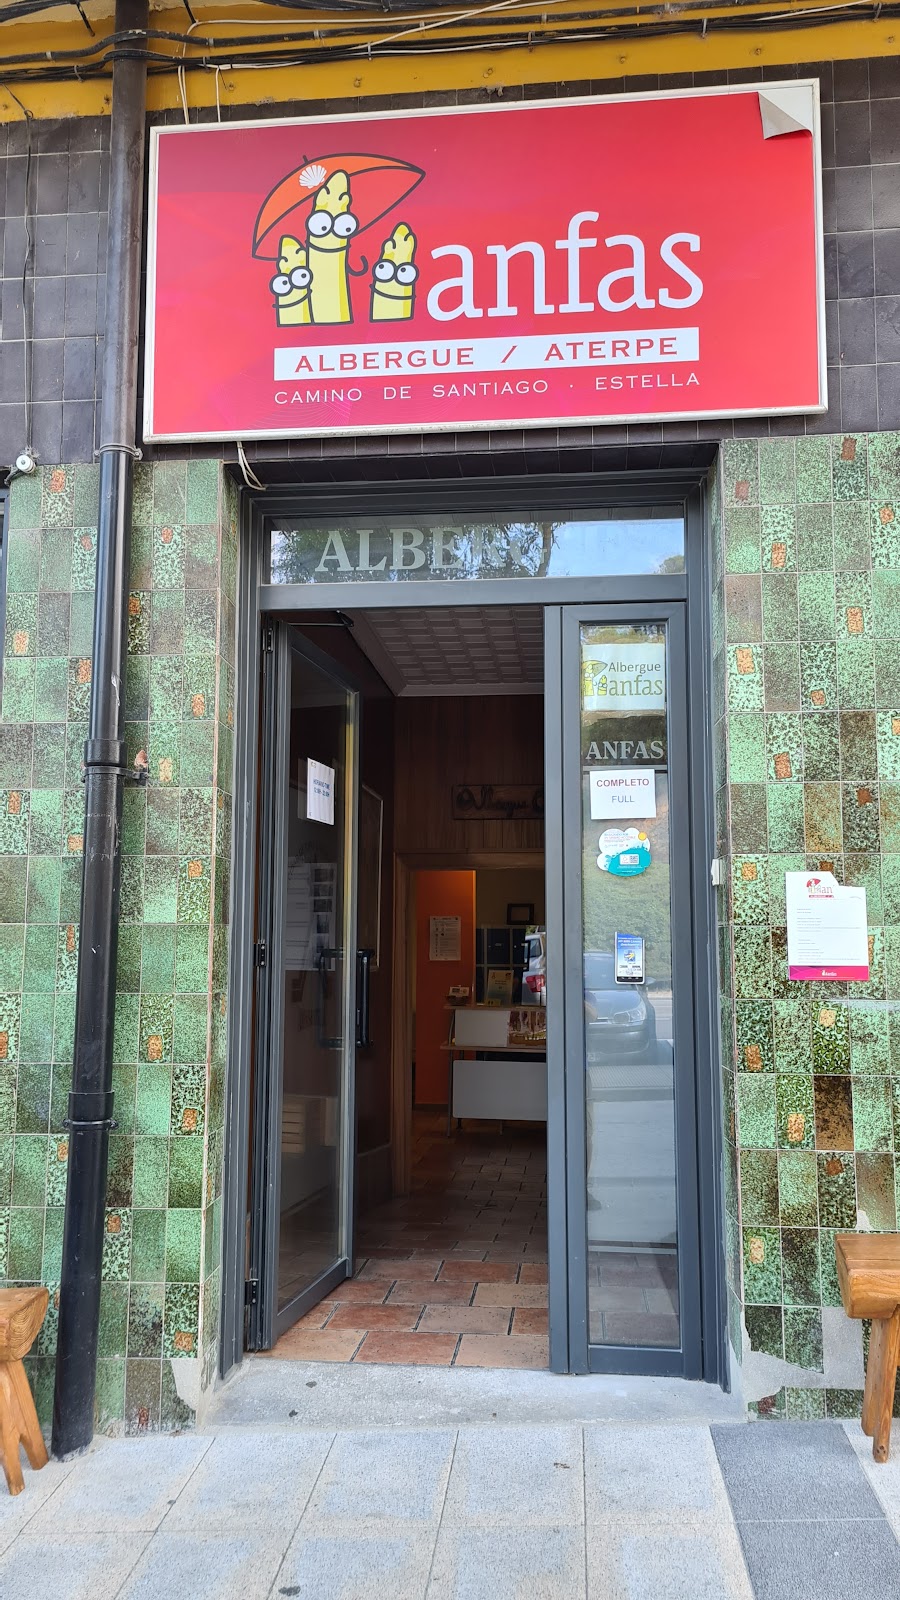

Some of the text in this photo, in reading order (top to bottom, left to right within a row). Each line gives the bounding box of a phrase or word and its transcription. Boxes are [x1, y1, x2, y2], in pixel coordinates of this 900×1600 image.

[426, 211, 703, 321] anfas
[294, 336, 678, 373] ALBERGUE / ATERPE
[274, 388, 362, 405] CAMINO
[383, 386, 412, 400] DE
[432, 379, 549, 398] SANTIAGO
[595, 372, 700, 391] ESTELLA
[608, 661, 661, 675] Albergue
[609, 675, 663, 696] anfas
[585, 740, 664, 760] ANFAS
[597, 779, 649, 787] COMPLETO
[611, 795, 635, 803] FULL
